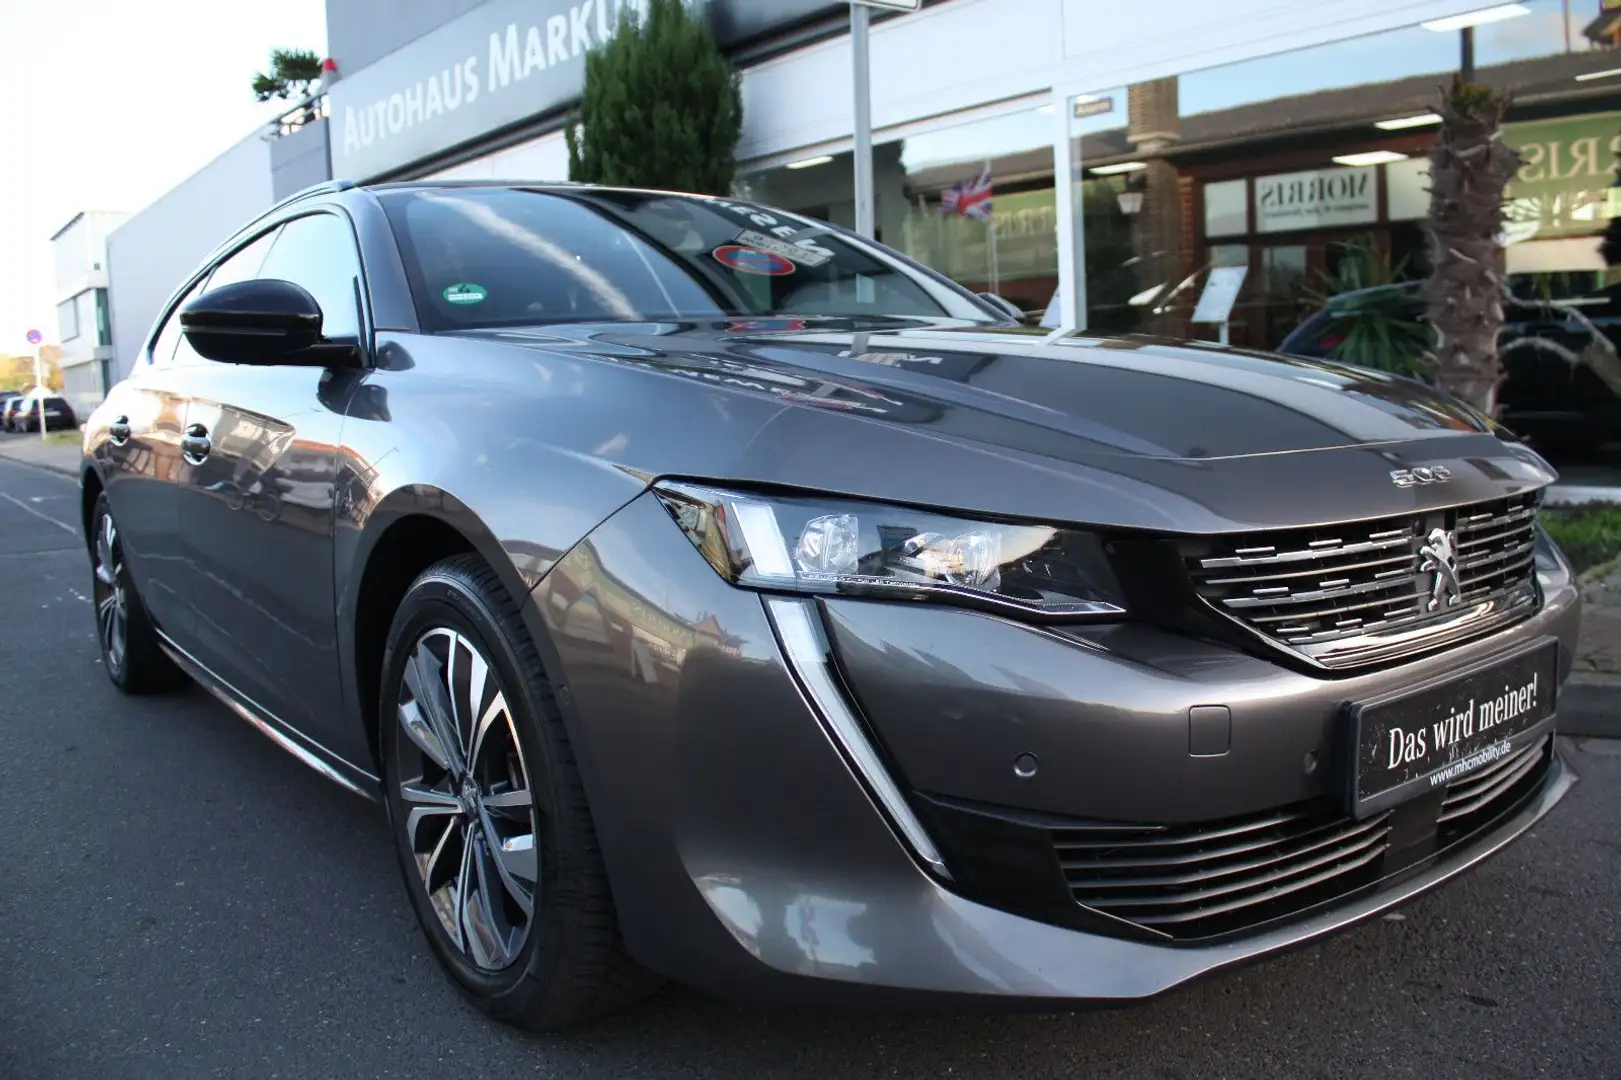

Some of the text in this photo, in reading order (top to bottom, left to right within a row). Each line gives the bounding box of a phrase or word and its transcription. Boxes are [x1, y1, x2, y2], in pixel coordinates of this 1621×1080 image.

[343, 56, 479, 155] AUTOHAUS
[1387, 672, 1538, 769] Das wird meiner!
[1430, 741, 1511, 786] www.mhcmobility.de
